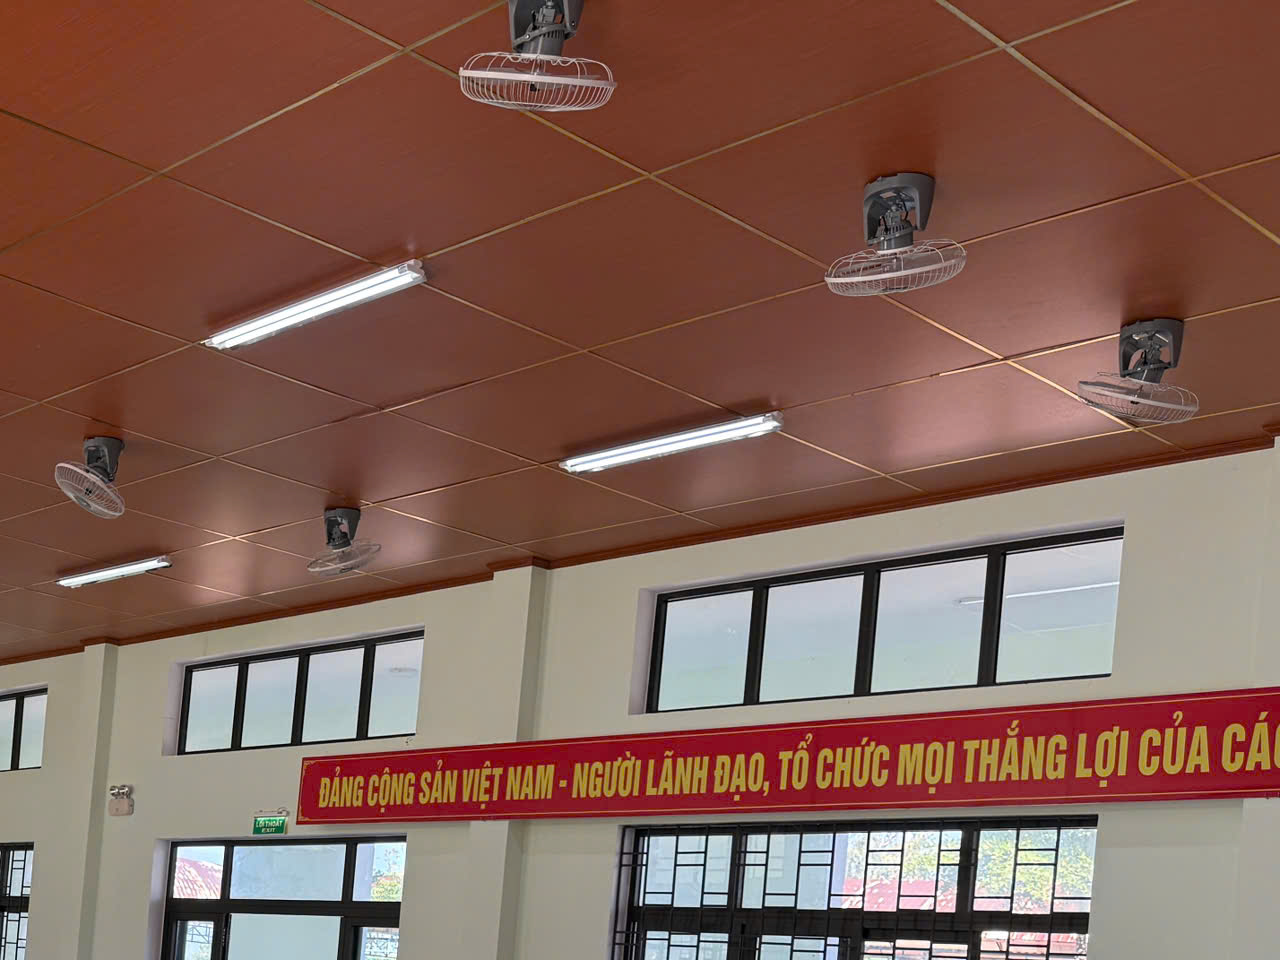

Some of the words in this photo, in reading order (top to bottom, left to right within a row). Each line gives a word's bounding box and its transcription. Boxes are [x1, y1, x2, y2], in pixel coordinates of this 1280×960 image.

[319, 766, 365, 808] ĐẢNG
[367, 767, 416, 813] CỘNG
[418, 760, 458, 805] SẢN
[462, 761, 503, 809] VIỆT
[506, 764, 555, 801] NAM
[571, 751, 641, 798] NGƯỜI
[645, 751, 710, 796] LÃNH
[713, 752, 770, 801] ĐẠO,
[778, 733, 813, 790] TỔ
[815, 737, 890, 789] CHỨC
[896, 741, 955, 794] MỌI
[963, 720, 1068, 783] THẮNG
[1075, 726, 1130, 788] LỢI
[1138, 711, 1210, 776] CỦA
[1221, 711, 1280, 772] CÁ
